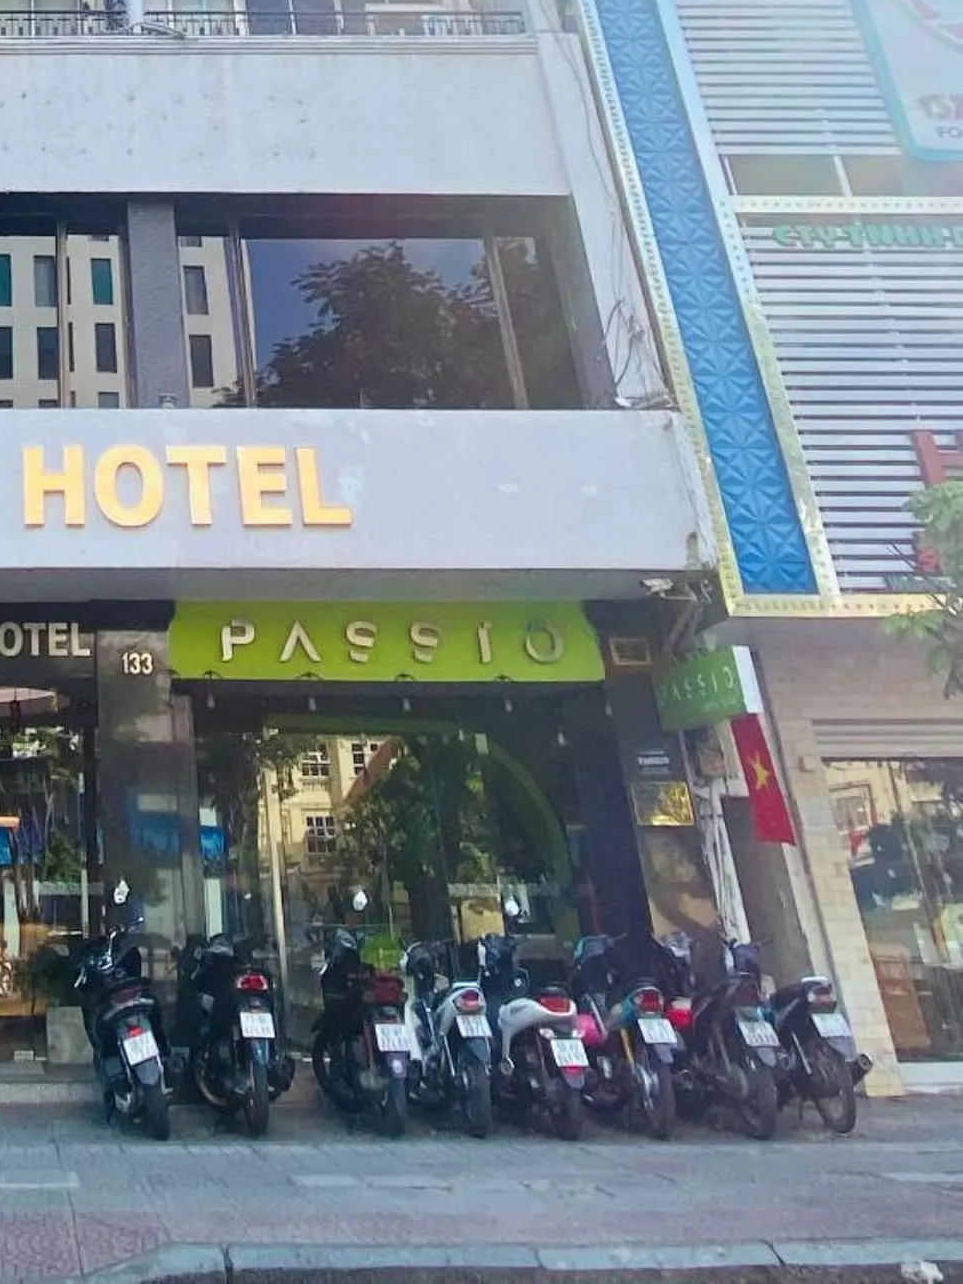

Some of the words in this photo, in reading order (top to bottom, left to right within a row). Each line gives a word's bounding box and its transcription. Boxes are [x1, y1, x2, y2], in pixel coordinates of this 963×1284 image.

[23, 444, 352, 528] HOTEL
[122, 651, 153, 674] 133
[221, 619, 564, 664] PASSIO
